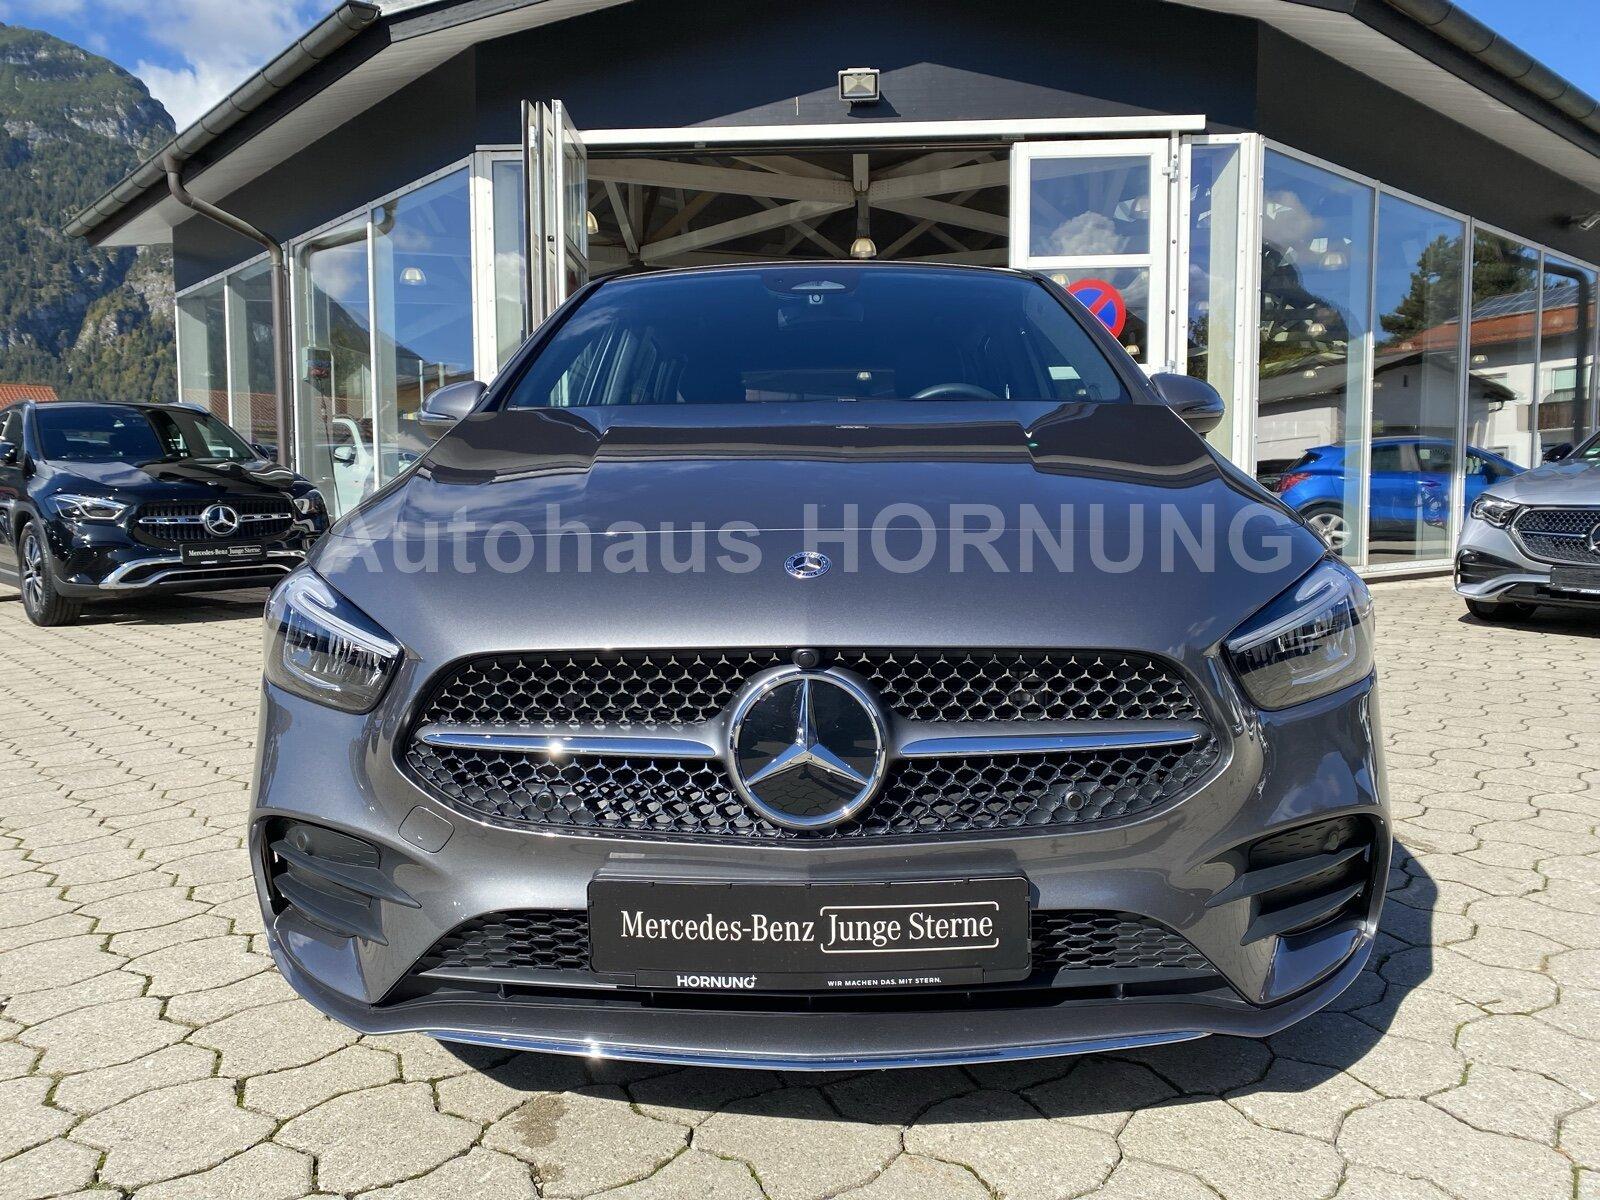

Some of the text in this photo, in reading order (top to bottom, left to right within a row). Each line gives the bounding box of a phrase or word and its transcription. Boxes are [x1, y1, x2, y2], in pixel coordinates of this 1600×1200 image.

[621, 910, 993, 947] Mercedes-Benz Junge Sterne
[676, 975, 757, 989] HORNUNG
